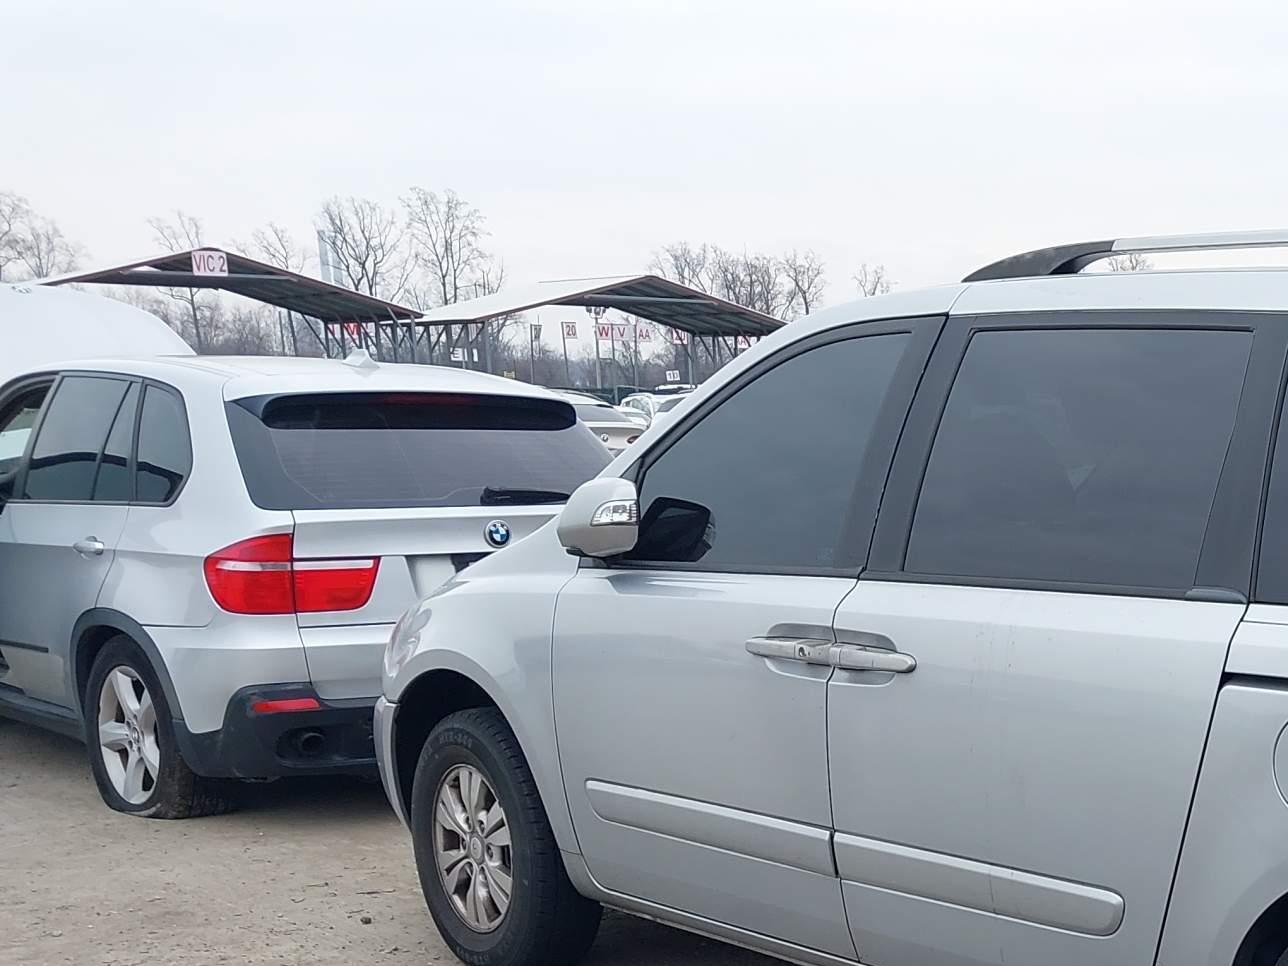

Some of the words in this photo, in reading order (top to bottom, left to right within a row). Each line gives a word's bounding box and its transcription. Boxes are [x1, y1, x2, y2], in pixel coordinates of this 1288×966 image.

[192, 254, 216, 272] VIC
[218, 255, 227, 273] 2
[565, 325, 577, 337] 20
[599, 326, 610, 338] W
[617, 327, 626, 338] V
[639, 329, 651, 340] AA
